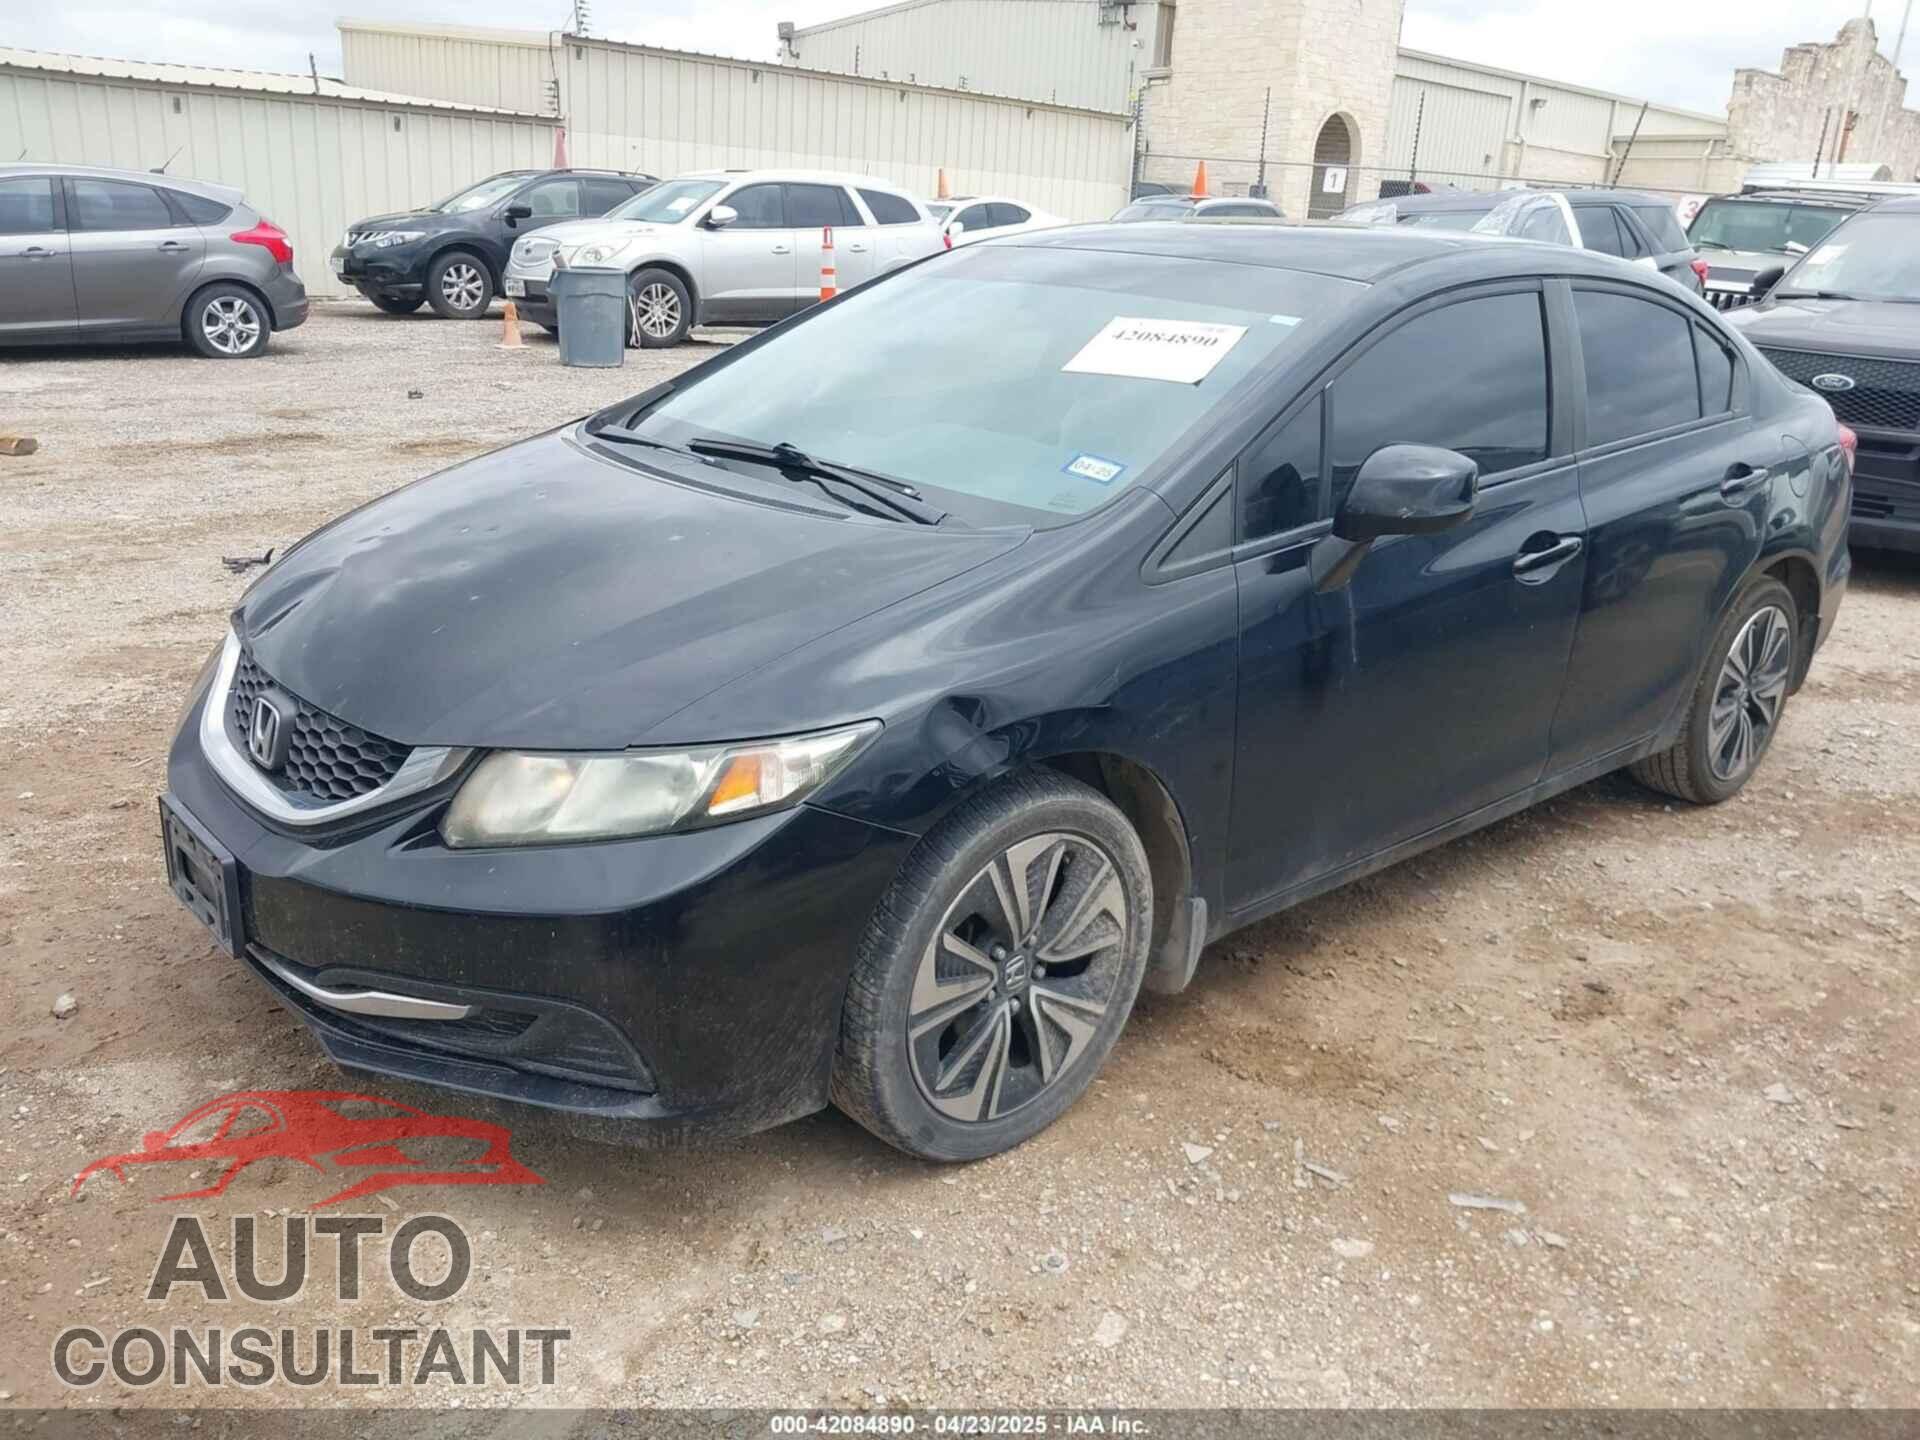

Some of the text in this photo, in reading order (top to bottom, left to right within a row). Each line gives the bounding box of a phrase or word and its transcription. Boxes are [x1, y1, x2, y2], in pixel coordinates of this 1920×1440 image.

[1330, 172, 1339, 189] 1
[1683, 200, 1700, 219] 3
[1112, 329, 1219, 347] 42084890
